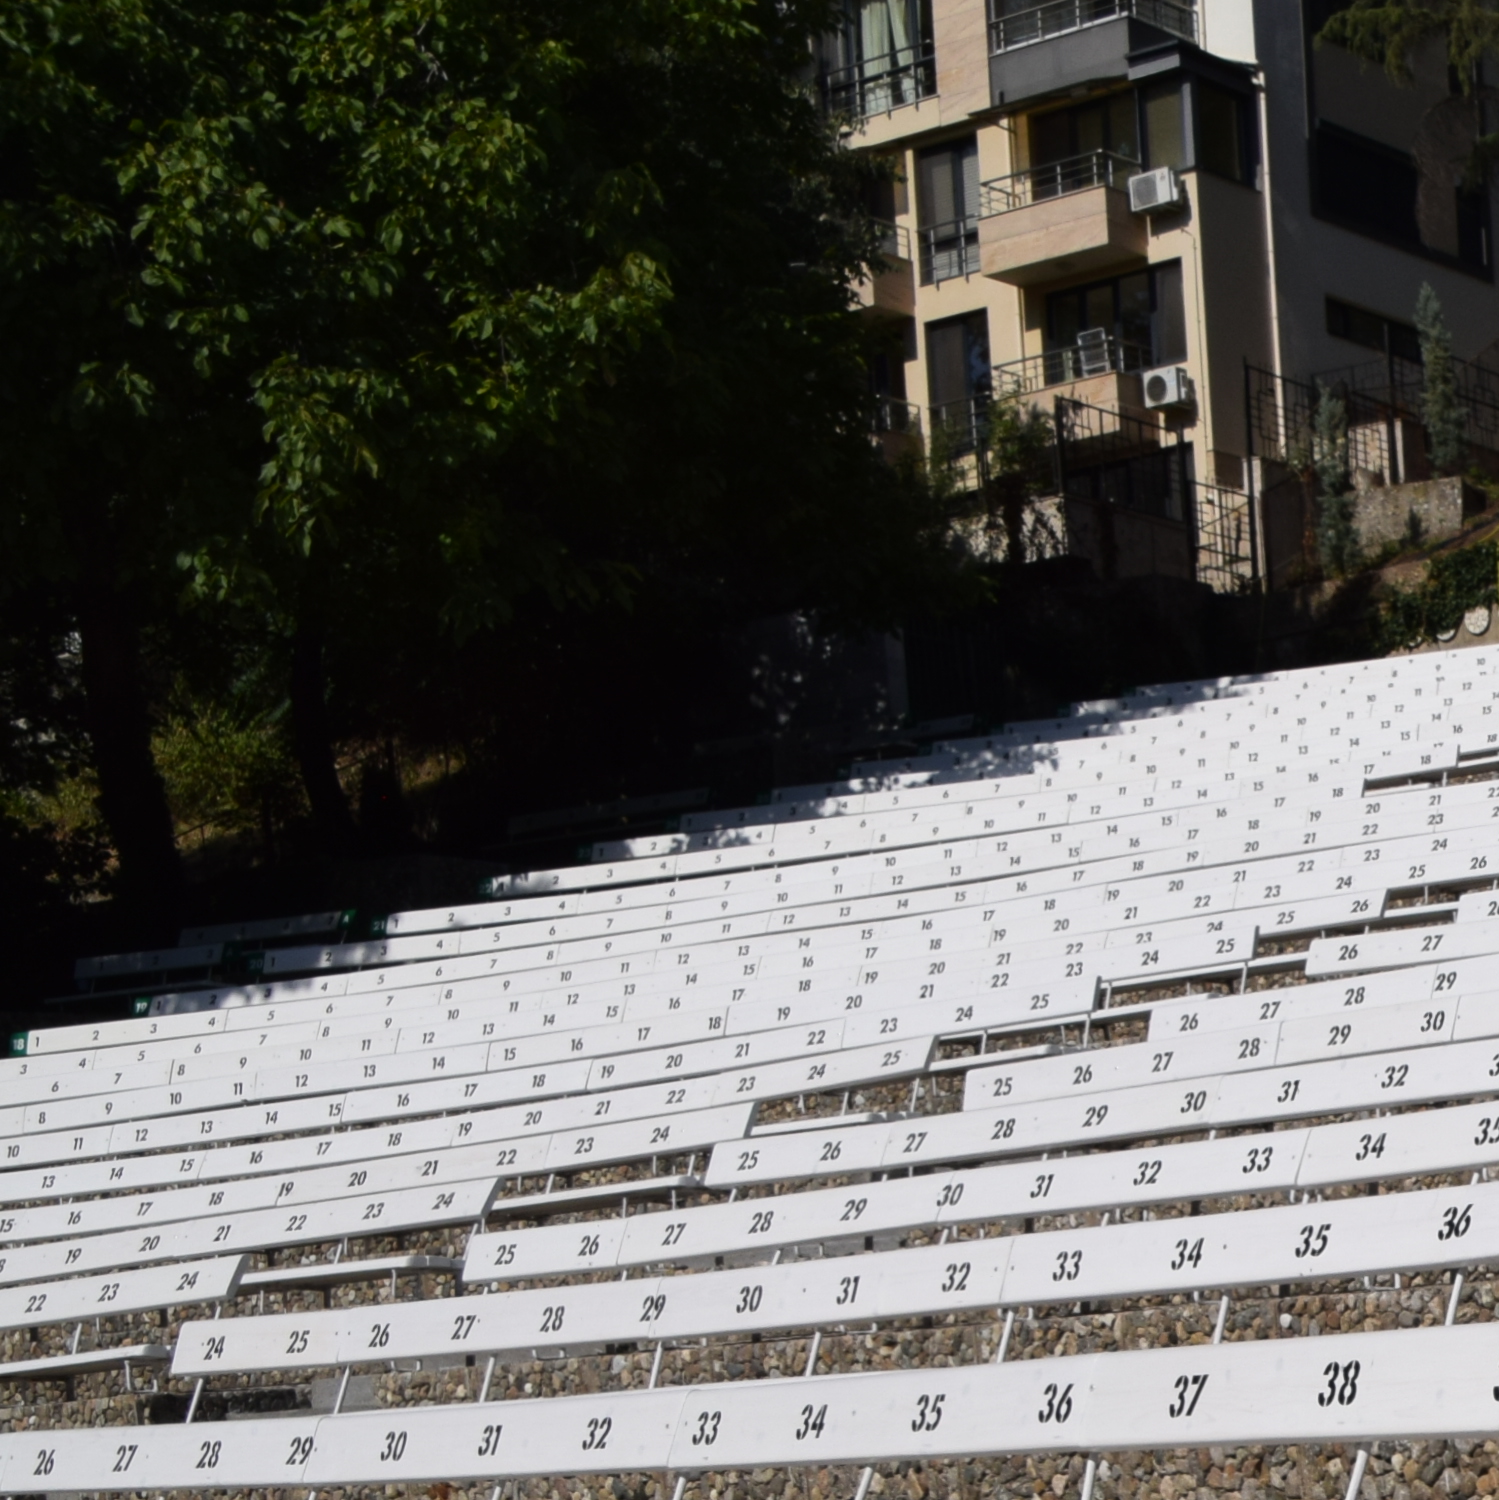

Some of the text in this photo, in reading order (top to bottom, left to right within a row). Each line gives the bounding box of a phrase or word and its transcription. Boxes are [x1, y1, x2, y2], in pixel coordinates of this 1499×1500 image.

[1278, 1080, 1299, 1102] 31
[1381, 1065, 1408, 1088] 32
[495, 1244, 516, 1265] 25
[578, 1235, 599, 1256] 26
[662, 1223, 686, 1245] 27
[748, 1211, 773, 1234] 28
[840, 1198, 867, 1221] 29
[937, 1184, 964, 1206] 30
[1030, 1174, 1054, 1198] 31
[1133, 1161, 1161, 1185] 32
[1243, 1147, 1273, 1173] 33
[1356, 1133, 1386, 1160] 34
[204, 1336, 225, 1360] 24
[286, 1330, 310, 1353] 25
[369, 1324, 389, 1347] 26
[451, 1315, 476, 1340] 27
[540, 1306, 564, 1332] 28
[640, 1295, 666, 1321] 29
[736, 1286, 762, 1313] 30
[837, 1276, 860, 1304] 31
[942, 1263, 970, 1292] 32
[1053, 1251, 1082, 1281] 33
[1172, 1238, 1204, 1270] 34
[1295, 1224, 1331, 1257] 35
[1438, 1204, 1472, 1240] 36
[34, 1450, 55, 1475] 26
[113, 1445, 138, 1472] 27
[196, 1441, 221, 1468] 28
[286, 1437, 313, 1465] 29
[381, 1432, 407, 1461] 30
[478, 1425, 502, 1456] 31
[582, 1418, 611, 1450] 32
[692, 1412, 721, 1445] 33
[796, 1405, 827, 1440] 34
[912, 1394, 945, 1431] 35
[1039, 1384, 1073, 1422] 36
[1170, 1375, 1208, 1417] 37
[1318, 1361, 1360, 1406] 38
